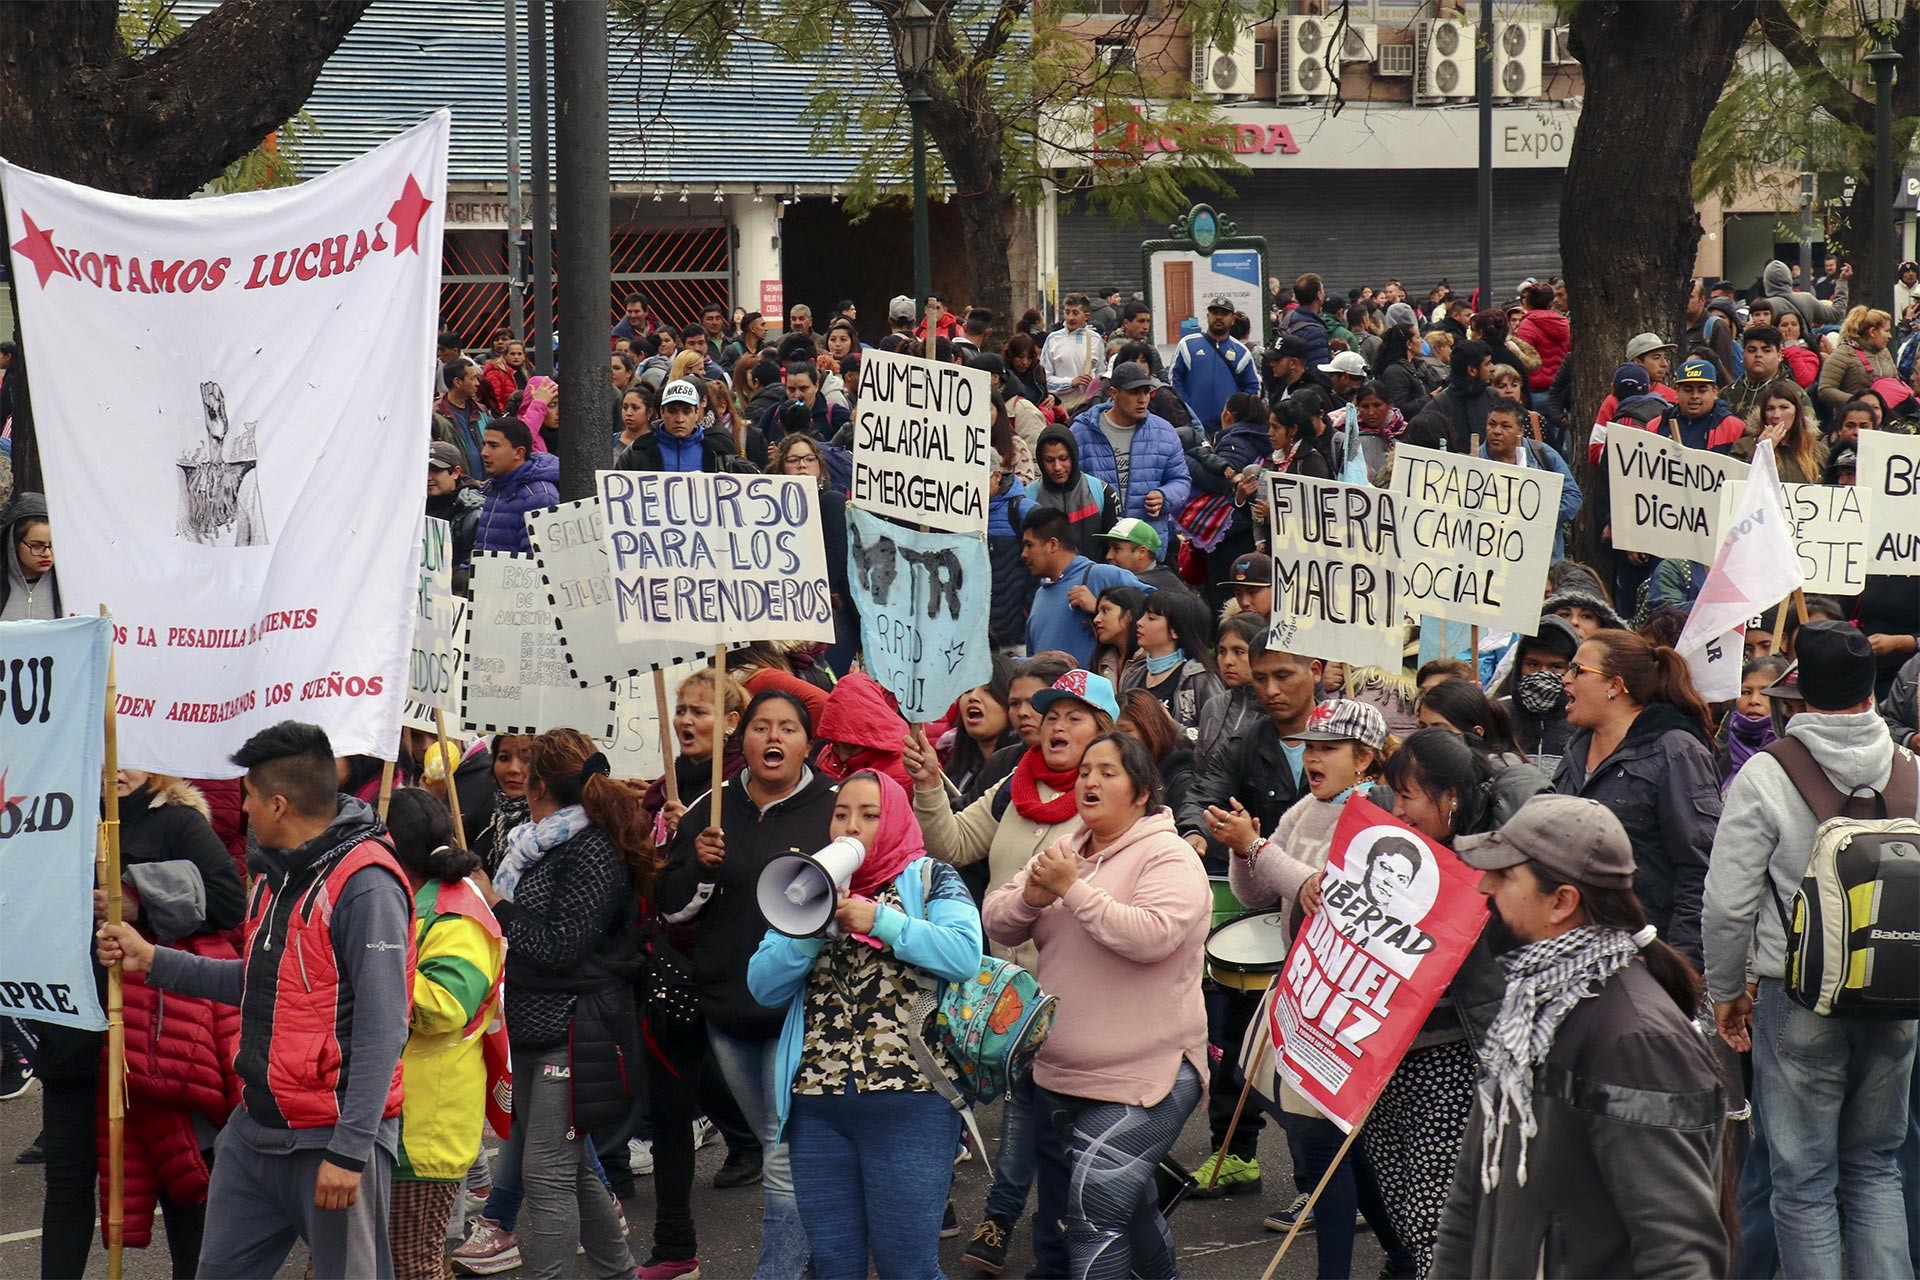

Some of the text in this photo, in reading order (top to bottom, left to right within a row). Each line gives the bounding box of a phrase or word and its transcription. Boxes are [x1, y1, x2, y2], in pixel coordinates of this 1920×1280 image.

[1504, 126, 1564, 159] Expo
[858, 358, 973, 417] AUMENTO
[965, 425, 986, 466] DE
[603, 473, 809, 528] RECURSO
[1399, 455, 1542, 522] TRABAJO
[1270, 477, 1402, 559] FUERA
[611, 527, 716, 572] PARA
[729, 529, 801, 575] LOS
[615, 575, 832, 624] MERENDEROS
[1273, 556, 1396, 628] MACRI
[137, 626, 157, 647] LA
[167, 627, 247, 648] PESADILLA
[265, 682, 294, 707] LOS
[300, 671, 384, 700] SUEÑOS
[1306, 911, 1402, 1018] DANIEL
[1286, 942, 1383, 1058] RUIZ
[543, 1064, 571, 1078] FILA
